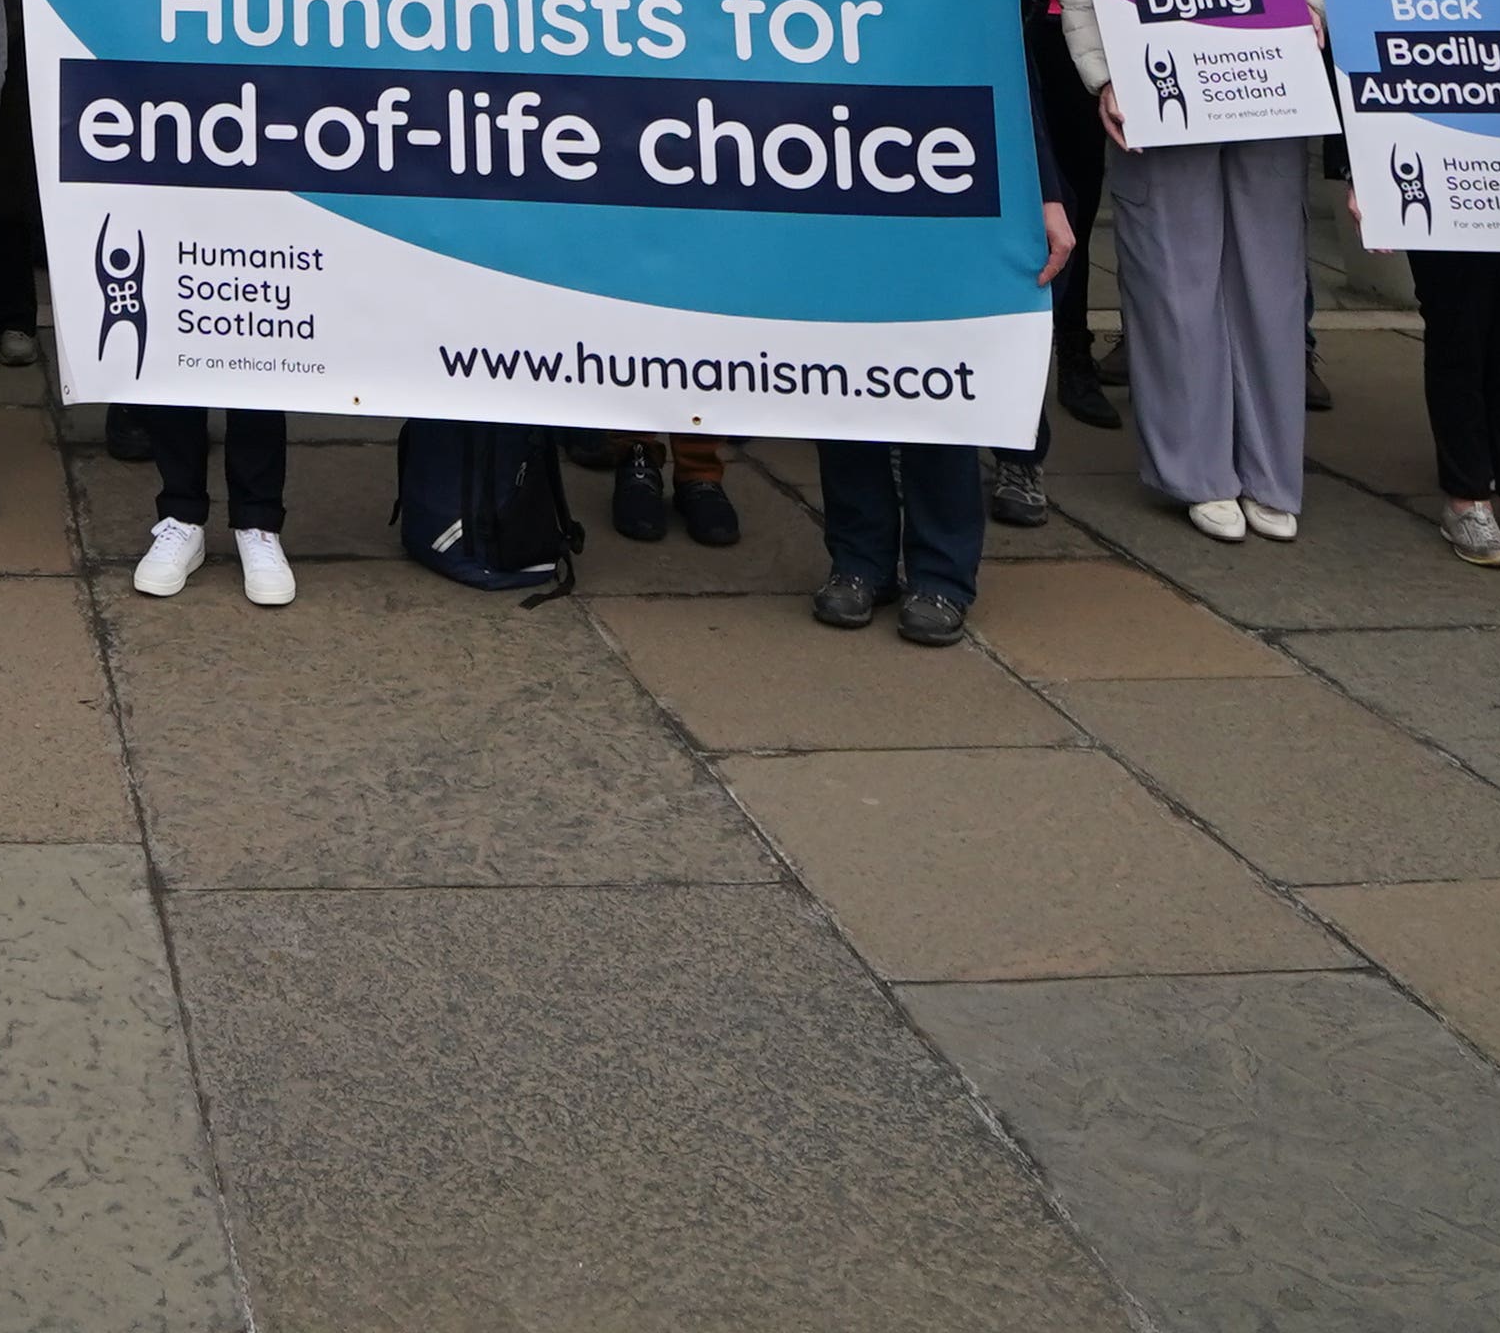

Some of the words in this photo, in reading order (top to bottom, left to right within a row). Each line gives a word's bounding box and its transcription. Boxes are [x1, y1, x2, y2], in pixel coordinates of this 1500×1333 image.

[77, 81, 601, 182] end-of-life
[639, 96, 978, 197] choice
[178, 240, 324, 274] Humanist
[178, 274, 293, 310] Society
[178, 309, 316, 342] Scotland
[178, 354, 200, 368] For
[205, 358, 224, 369] an
[228, 357, 276, 372] ethical
[281, 358, 326, 374] future
[438, 337, 977, 403] www.humanism.scot
